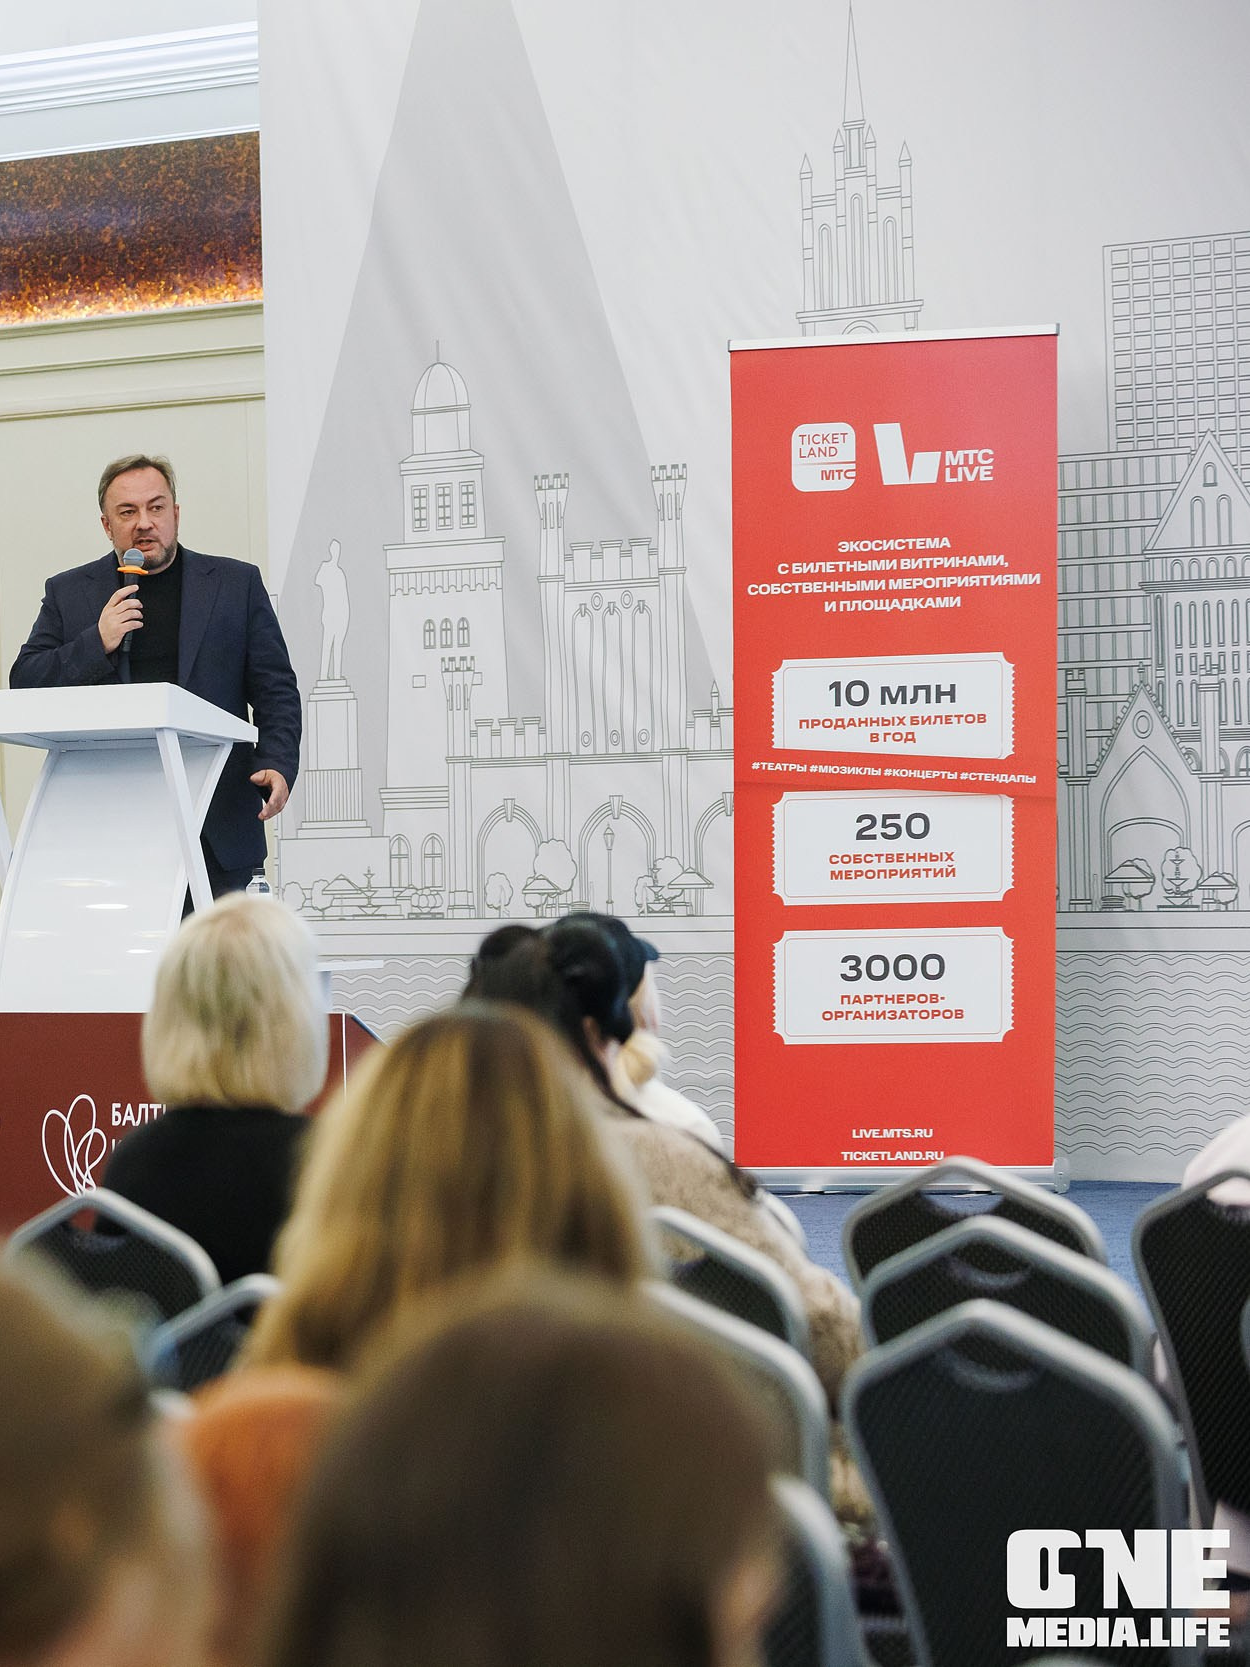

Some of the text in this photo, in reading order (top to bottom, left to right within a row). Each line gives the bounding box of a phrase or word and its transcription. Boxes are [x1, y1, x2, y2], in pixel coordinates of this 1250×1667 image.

[798, 432, 849, 446] TICKET
[798, 446, 838, 459] LAND
[944, 465, 994, 483] LIVE
[837, 536, 951, 553] ЭКОСИСТЕМА
[791, 558, 898, 575] БИЛЕТНЫМИ
[900, 554, 1009, 571] ВИТРИНАМИ,
[747, 573, 1041, 596] СОБСТВЕННЫМИ МЕРОПРИЯТИЯМИ
[824, 596, 962, 613] И ПЛОЩАДКАМИ
[828, 679, 871, 708] 10
[798, 712, 987, 730] ПРОДАННЫХ БИЛЕТОВ
[869, 731, 917, 744] В ГОД
[751, 761, 1037, 784] #ТЕАТРЫ #МЮЗИКЛЫ #КОНЦЕРТЫ #СТЕНДАПЫ
[854, 812, 931, 841] 250
[828, 851, 955, 866] СОБСТВЕННЫХ
[829, 864, 957, 881] МЕРОПРИЯТИЙ
[840, 953, 946, 982] 3000
[840, 993, 946, 1006] ПАРТНЕРОВ-
[821, 1008, 965, 1021] ОРГАНИЗАТОРОВ
[852, 1128, 934, 1139] LIVE.MTS.RU
[841, 1151, 944, 1161] TICKETLAND.RU
